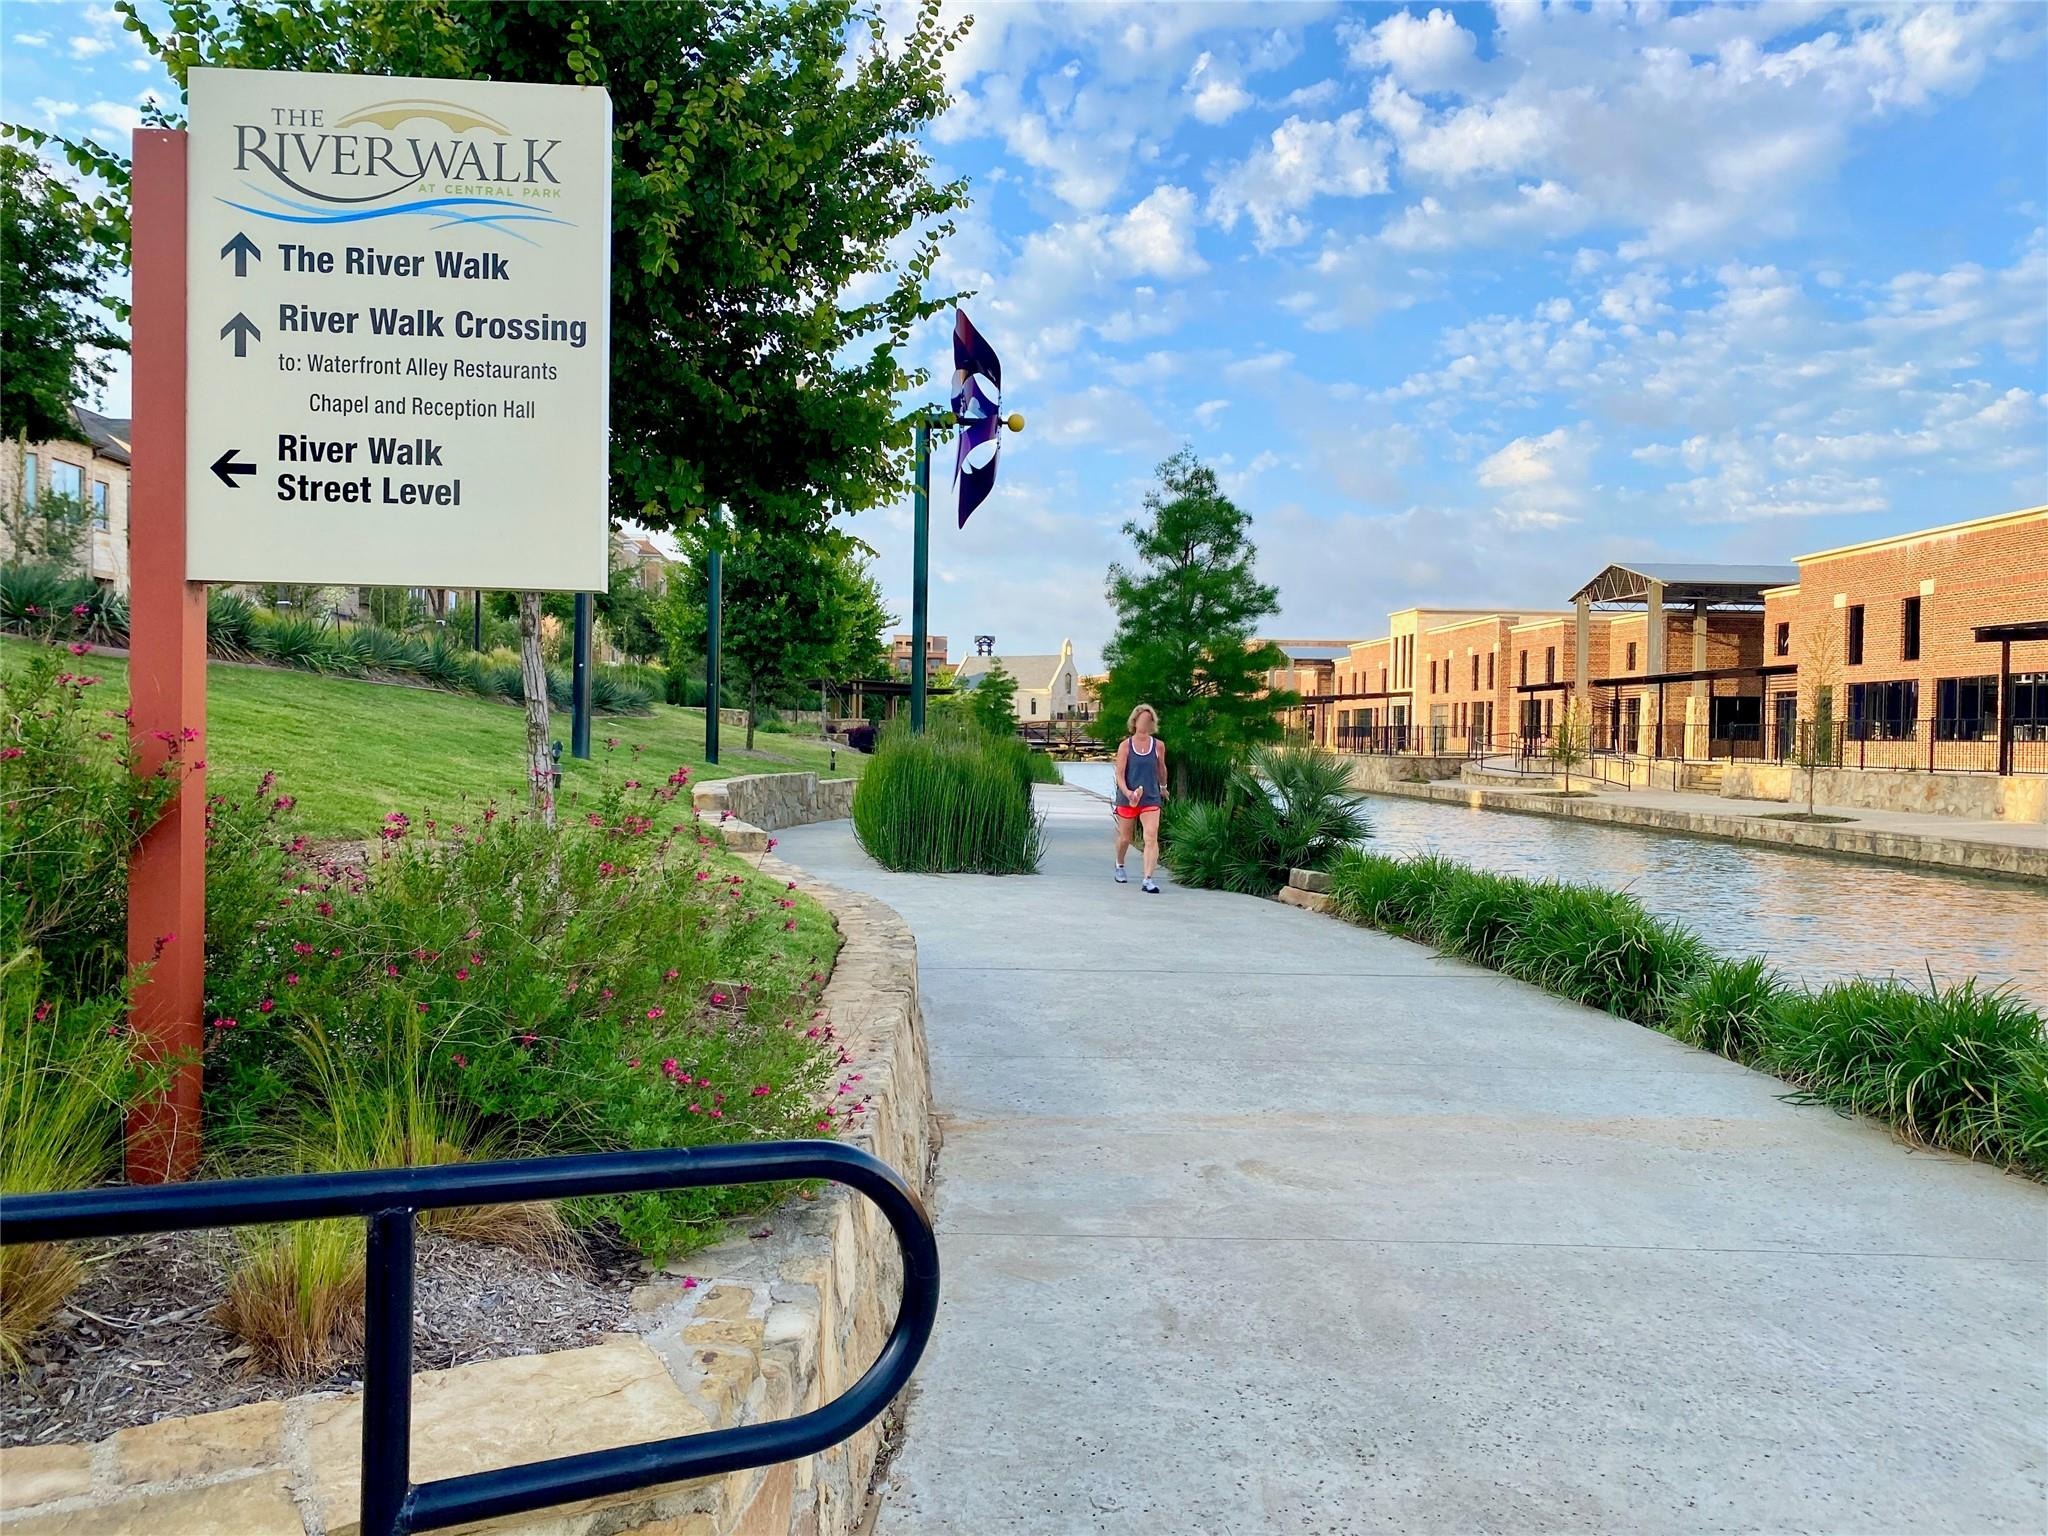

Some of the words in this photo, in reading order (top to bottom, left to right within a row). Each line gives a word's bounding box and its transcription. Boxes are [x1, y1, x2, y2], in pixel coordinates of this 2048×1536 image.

[271, 107, 324, 128] THE
[417, 183, 436, 193] AT
[444, 184, 514, 197] CENTRAL
[522, 187, 561, 198] PARK
[277, 243, 334, 274] The
[345, 246, 425, 277] River
[434, 250, 510, 281] Walk
[279, 303, 360, 334] River
[369, 307, 445, 338] Walk
[455, 310, 587, 349] Crossing
[278, 353, 301, 372] to:
[307, 353, 402, 376] Waterfront
[405, 357, 448, 381] Alley
[453, 359, 557, 381] Restaurants
[309, 393, 369, 417] Chapel
[374, 396, 406, 415] and
[412, 397, 497, 421] Reception
[503, 399, 535, 419] Hall
[278, 434, 358, 464] River
[367, 436, 443, 467] Walk
[277, 473, 372, 504] Street
[382, 476, 461, 506] Level
